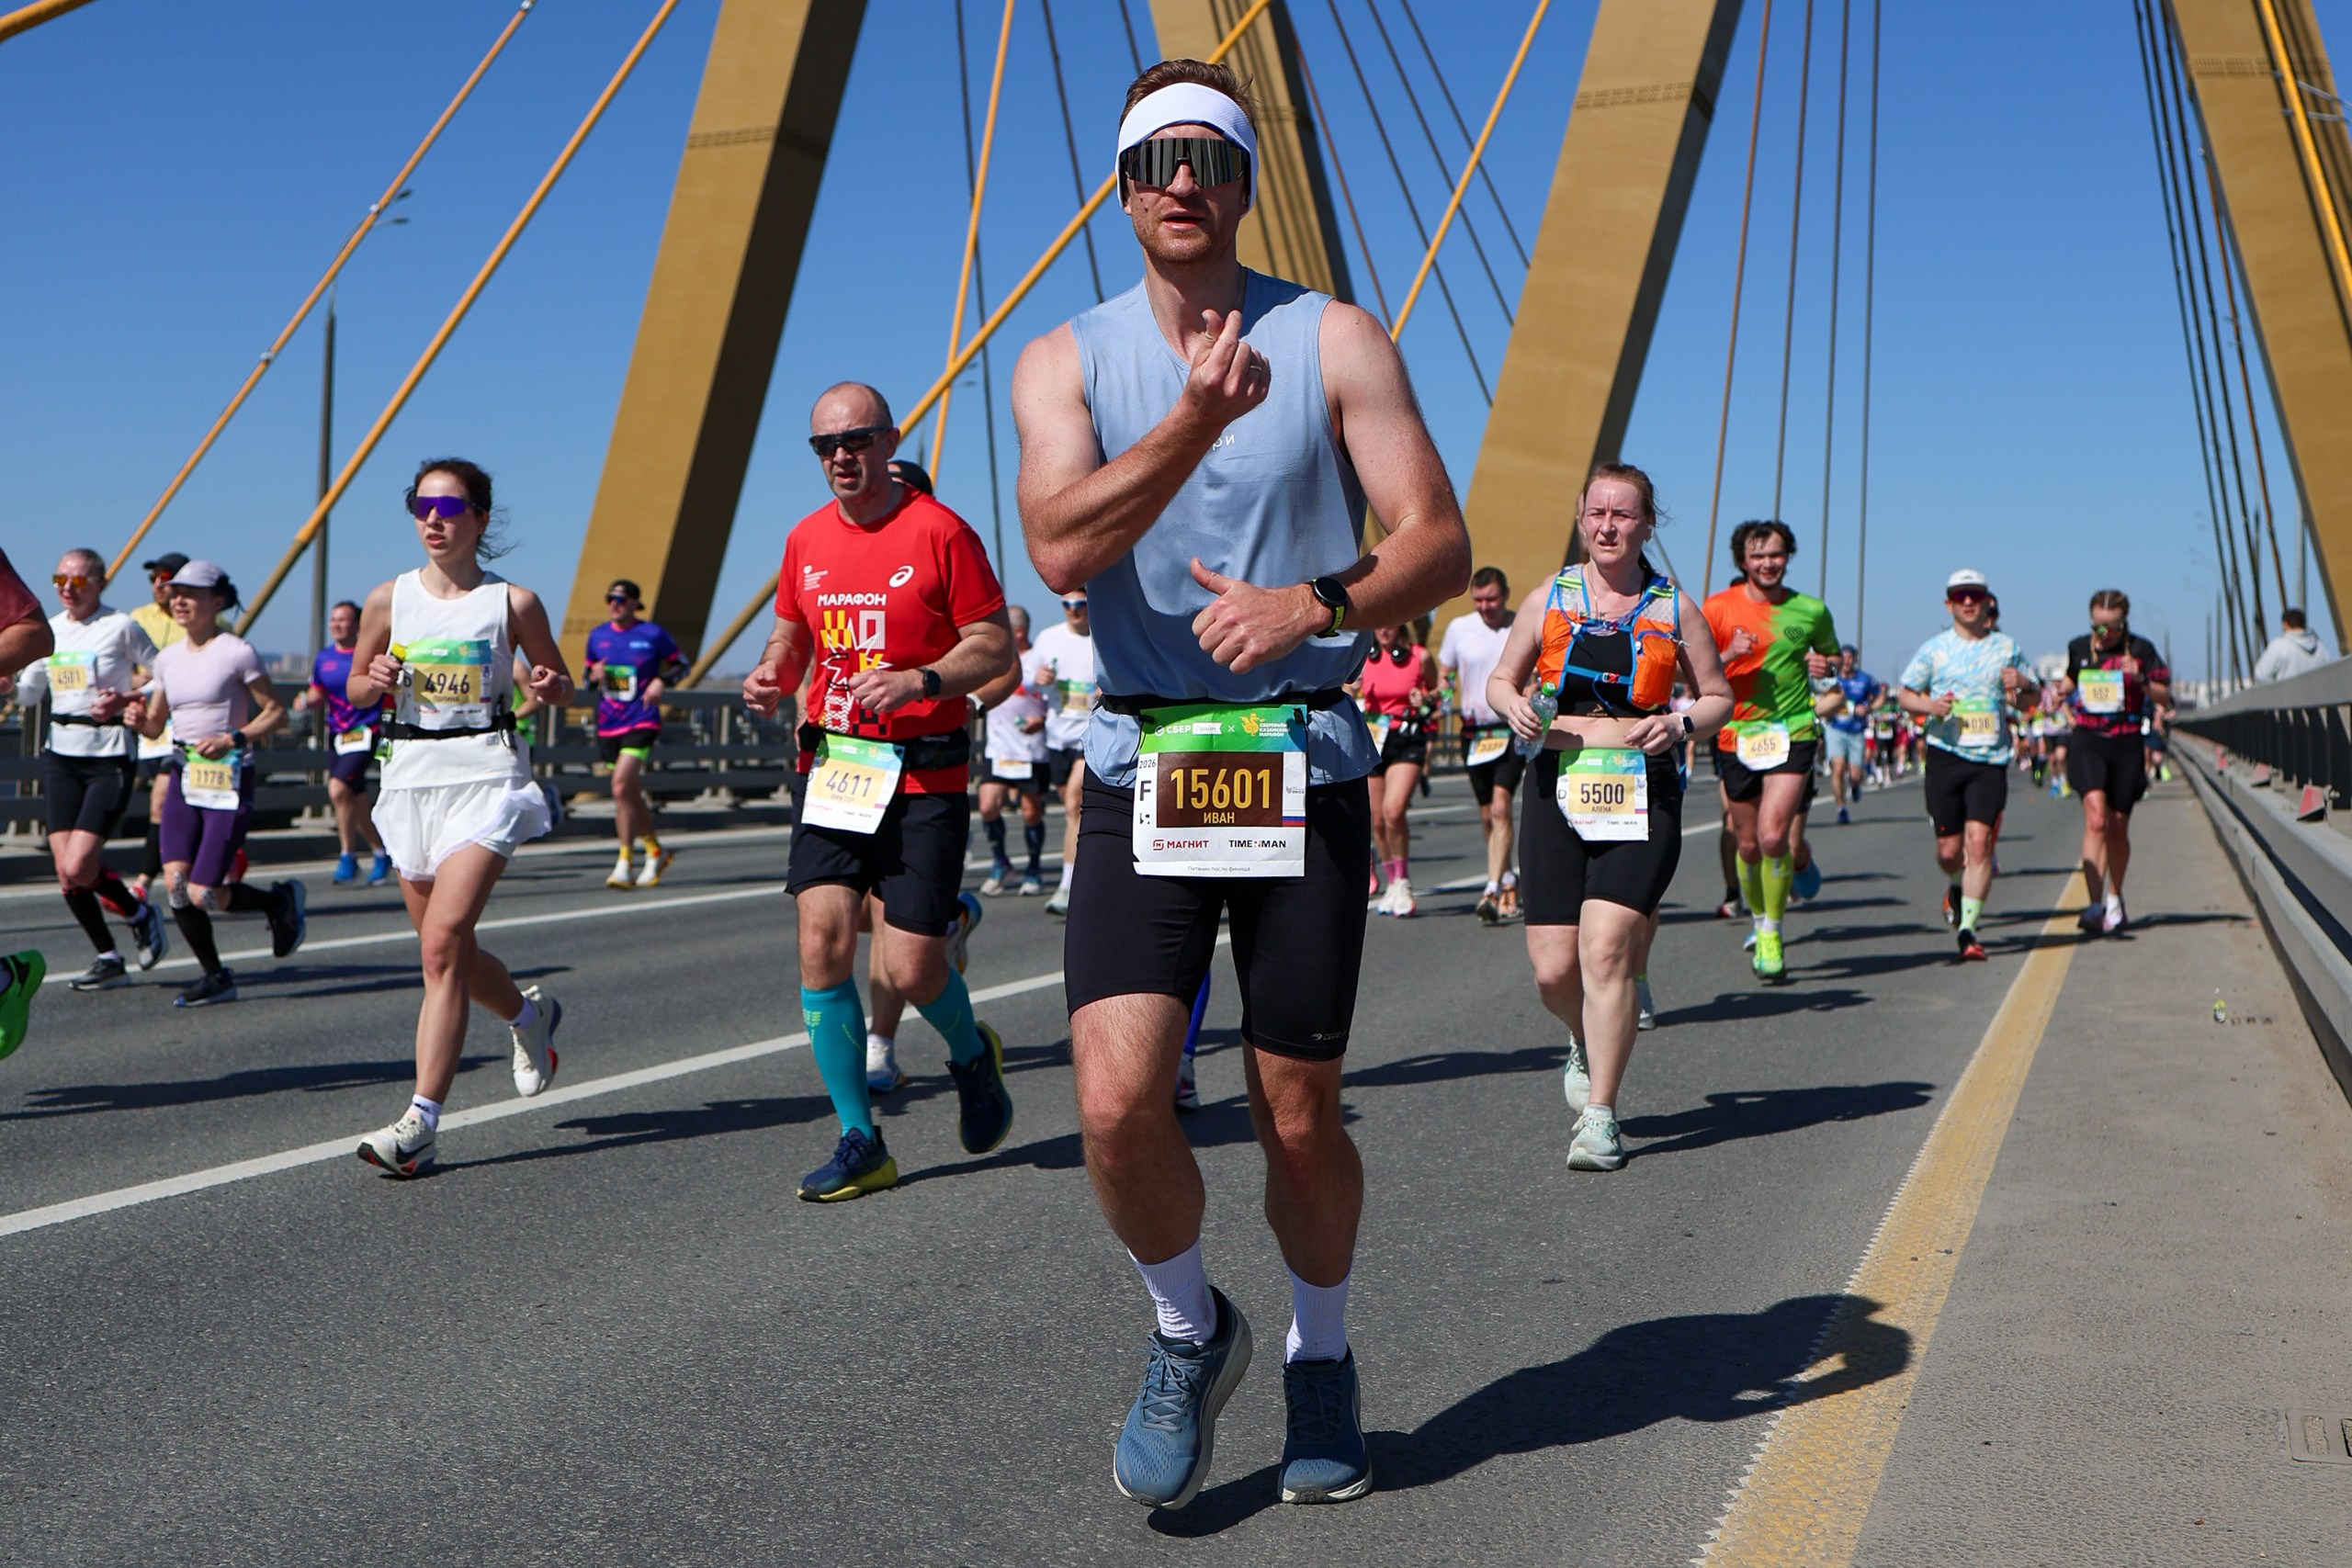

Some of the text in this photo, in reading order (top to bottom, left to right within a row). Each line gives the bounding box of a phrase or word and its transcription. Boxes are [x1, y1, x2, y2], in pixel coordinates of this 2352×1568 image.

[817, 592, 887, 606] МАРАФОН
[424, 672, 470, 694] 4946
[1166, 724, 1193, 734] СБЕР
[1750, 737, 1776, 752] 4655
[1138, 759, 1157, 769] 2026
[825, 770, 872, 797] 4611
[1170, 768, 1271, 809] 15601
[831, 793, 855, 802] ВИКТОР
[1139, 780, 1152, 802] F
[1557, 789, 1567, 800] D
[1580, 783, 1624, 805] 5500
[1203, 812, 1235, 824] ИВАН
[1167, 840, 1209, 849] МАГНИТ
